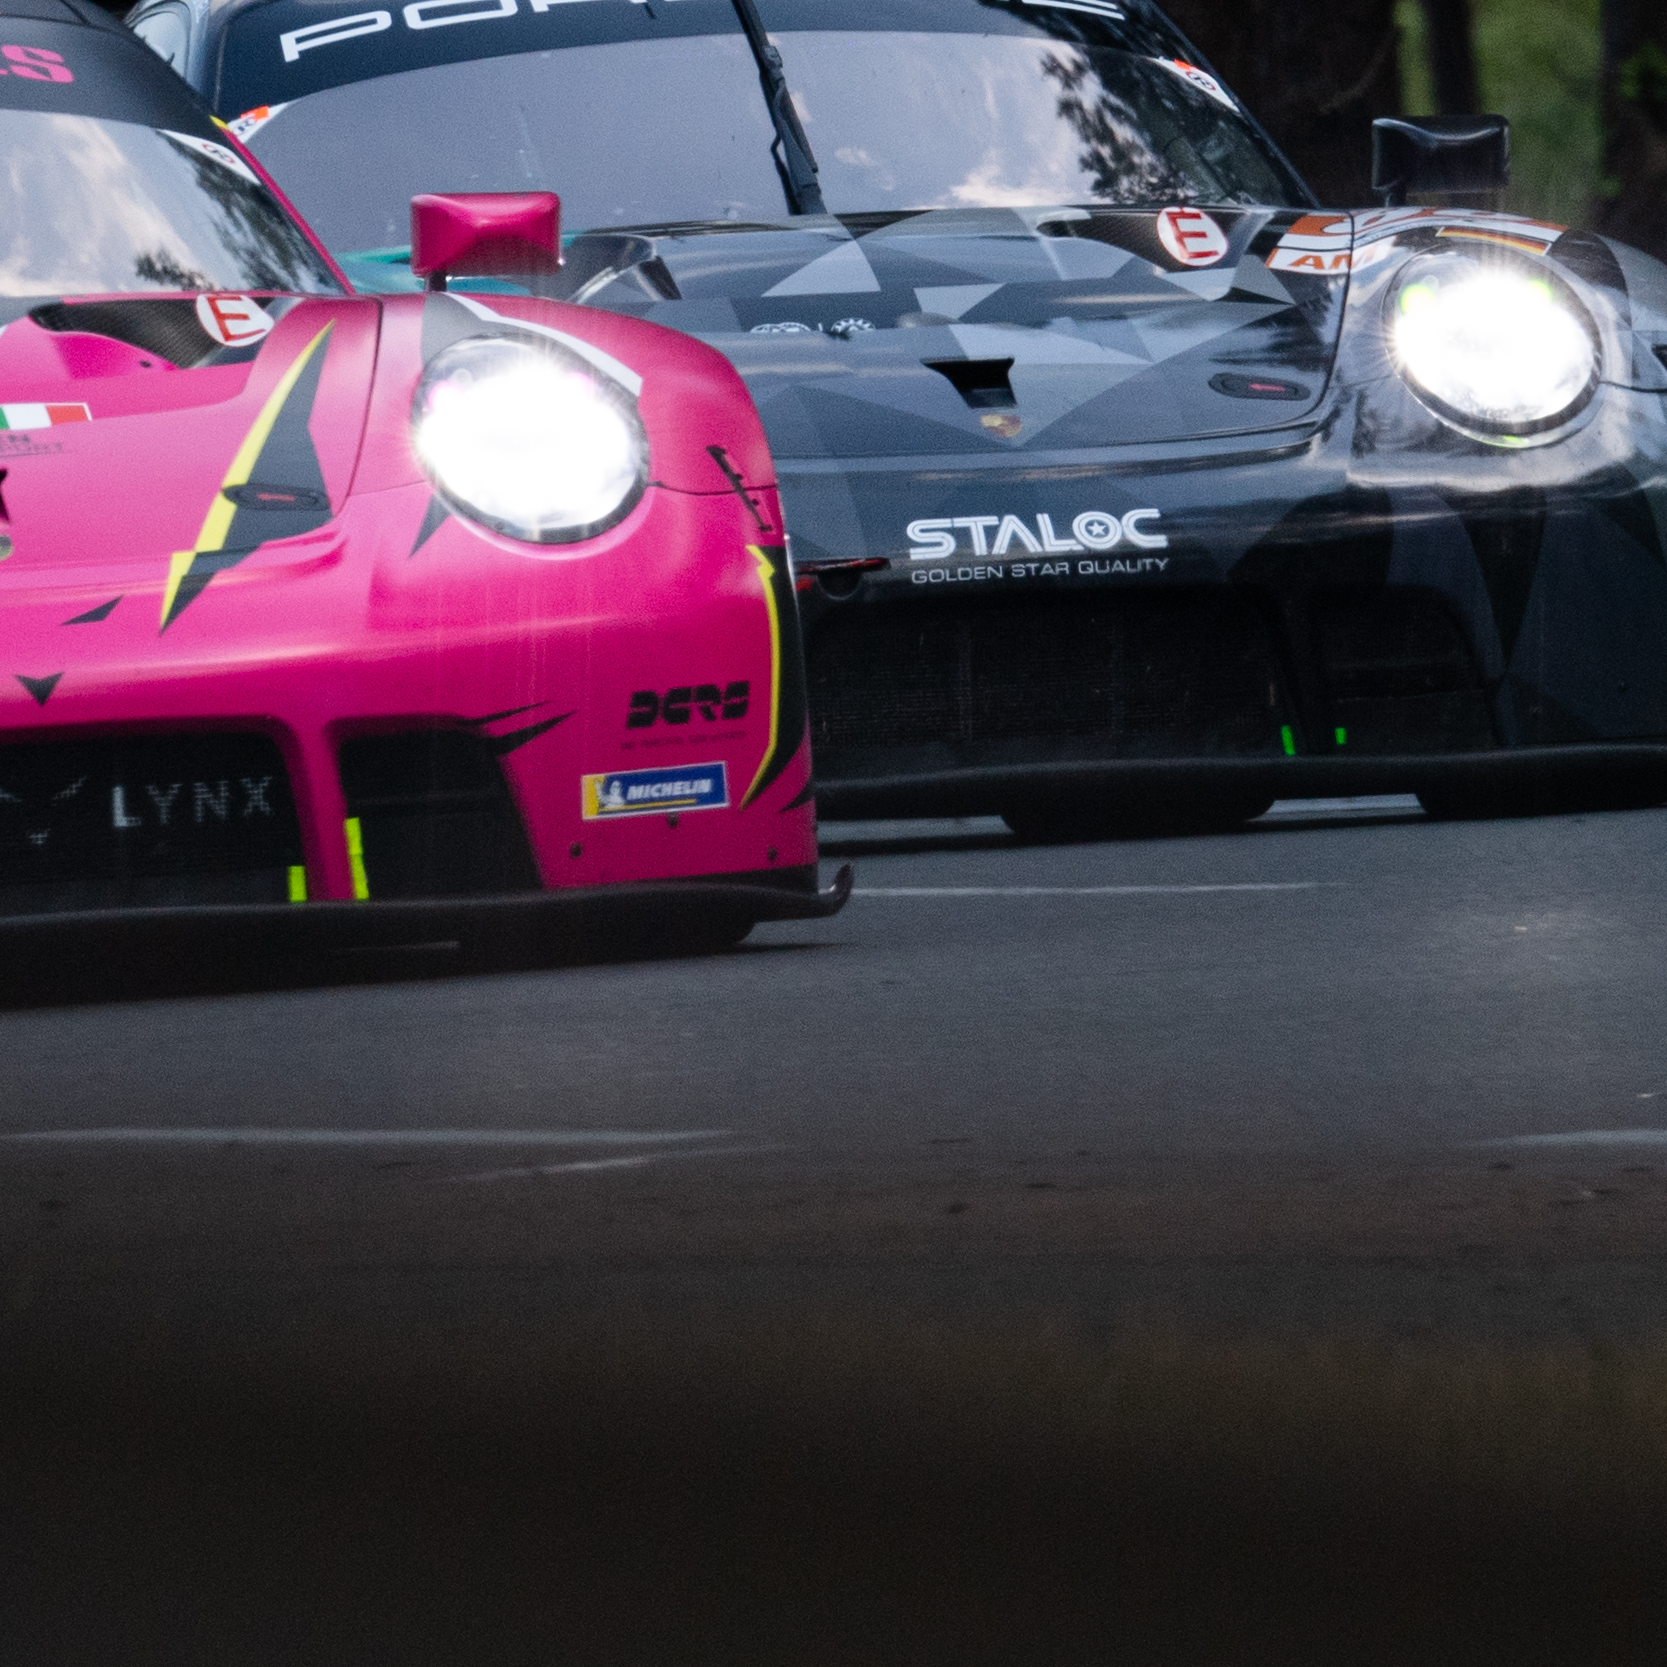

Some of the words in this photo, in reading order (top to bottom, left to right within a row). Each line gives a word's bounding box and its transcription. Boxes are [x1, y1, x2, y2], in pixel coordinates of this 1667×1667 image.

[1288, 250, 1376, 271] AM
[206, 294, 267, 343] E
[906, 508, 1169, 561] STALOC
[911, 564, 1004, 584] GOLDEN
[1011, 559, 1071, 578] STAR
[1078, 557, 1170, 575] QUALITY
[112, 776, 273, 828] LYNX
[626, 778, 713, 801] MICHELIN
